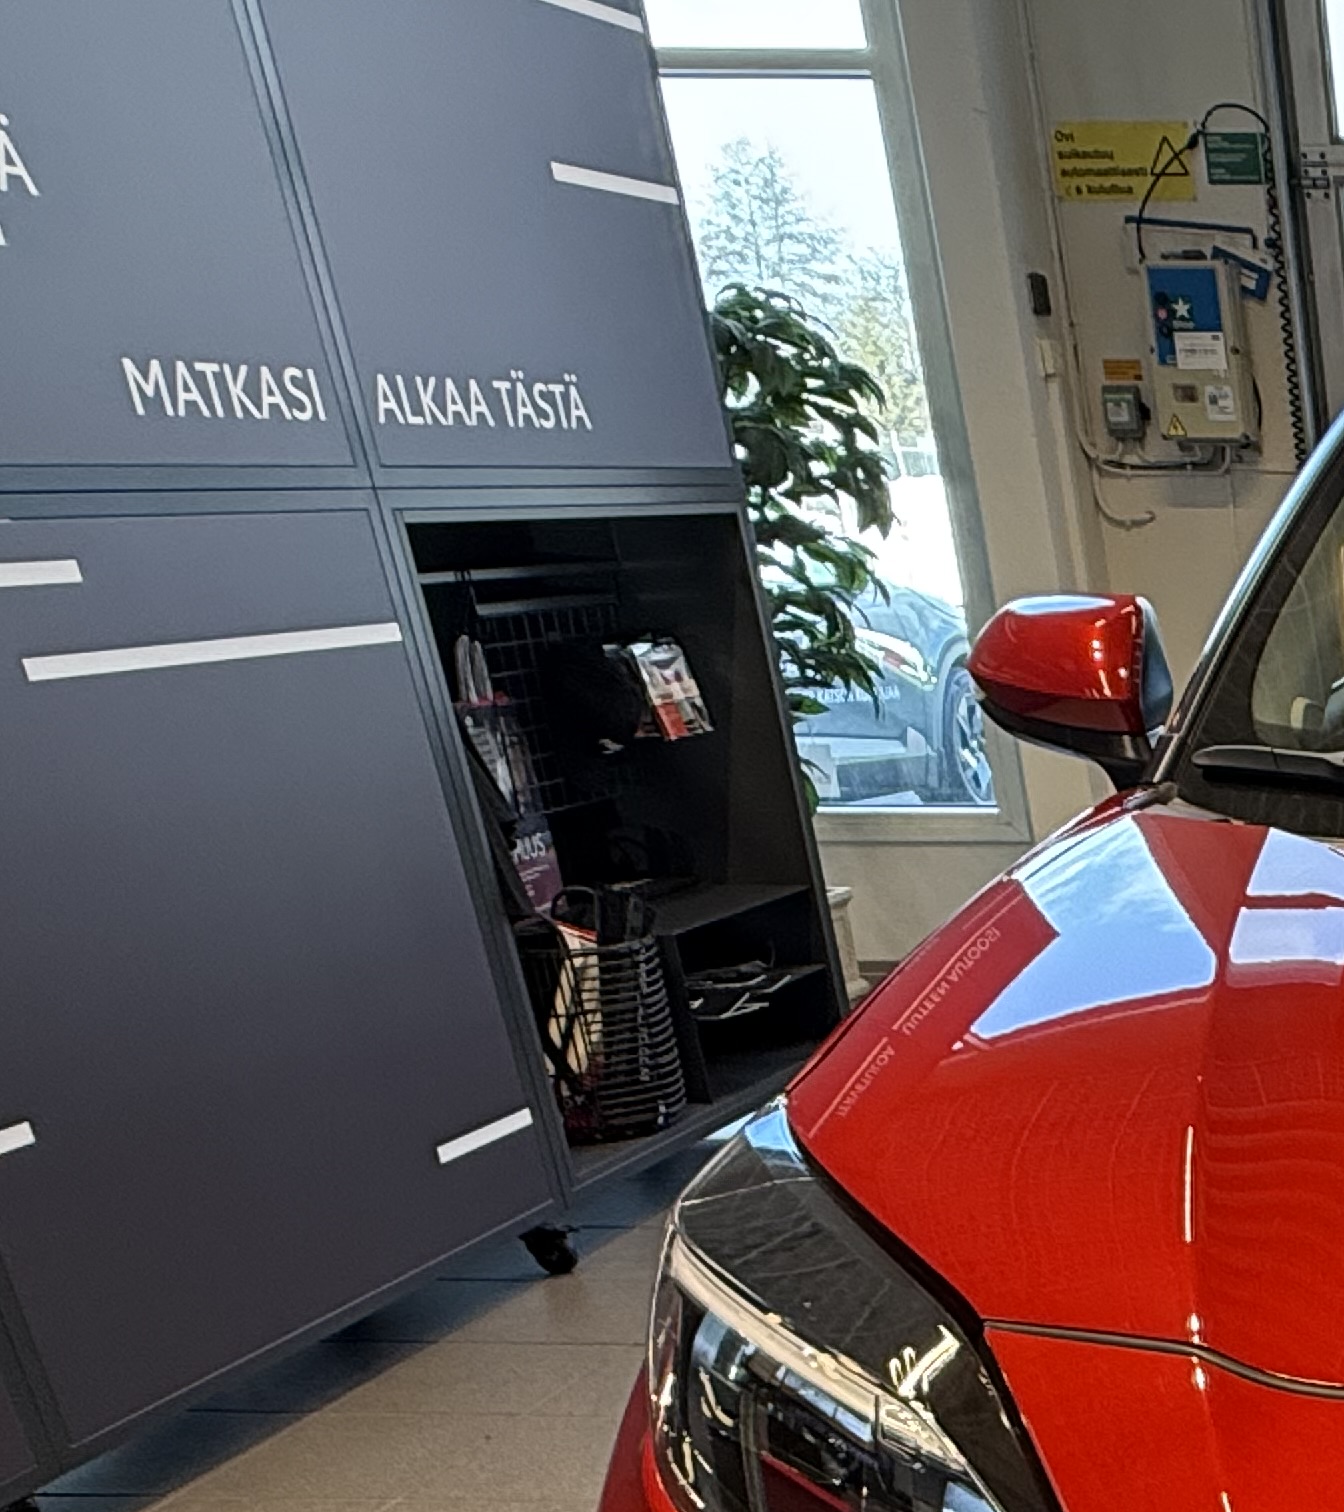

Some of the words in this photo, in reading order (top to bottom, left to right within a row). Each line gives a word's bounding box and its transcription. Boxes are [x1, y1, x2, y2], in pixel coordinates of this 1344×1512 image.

[121, 357, 327, 421] MATKASI
[376, 373, 495, 428] ALKAA
[492, 370, 593, 430] TÄSTÄ
